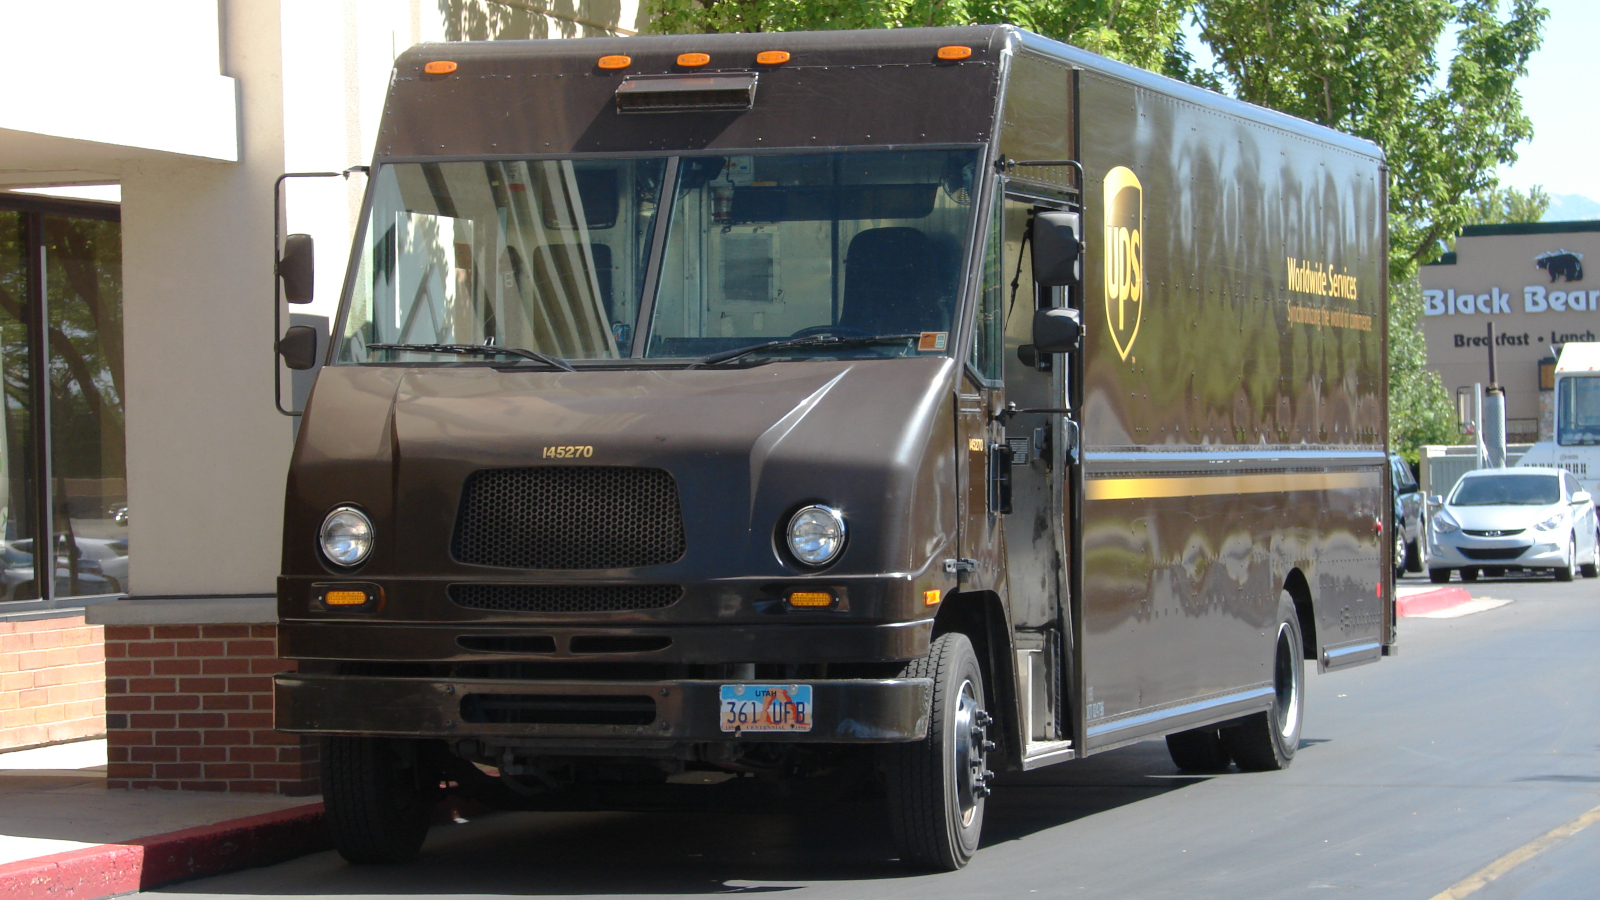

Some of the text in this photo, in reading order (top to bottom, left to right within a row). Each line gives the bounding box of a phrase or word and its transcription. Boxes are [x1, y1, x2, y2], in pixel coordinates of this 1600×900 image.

[1106, 226, 1140, 331] ups
[1287, 256, 1357, 300] Worldwide Services
[1422, 285, 1600, 316] Black Bear
[1551, 330, 1595, 344] Lunch
[542, 445, 593, 459] 145270
[726, 701, 805, 724] 361 UFB
